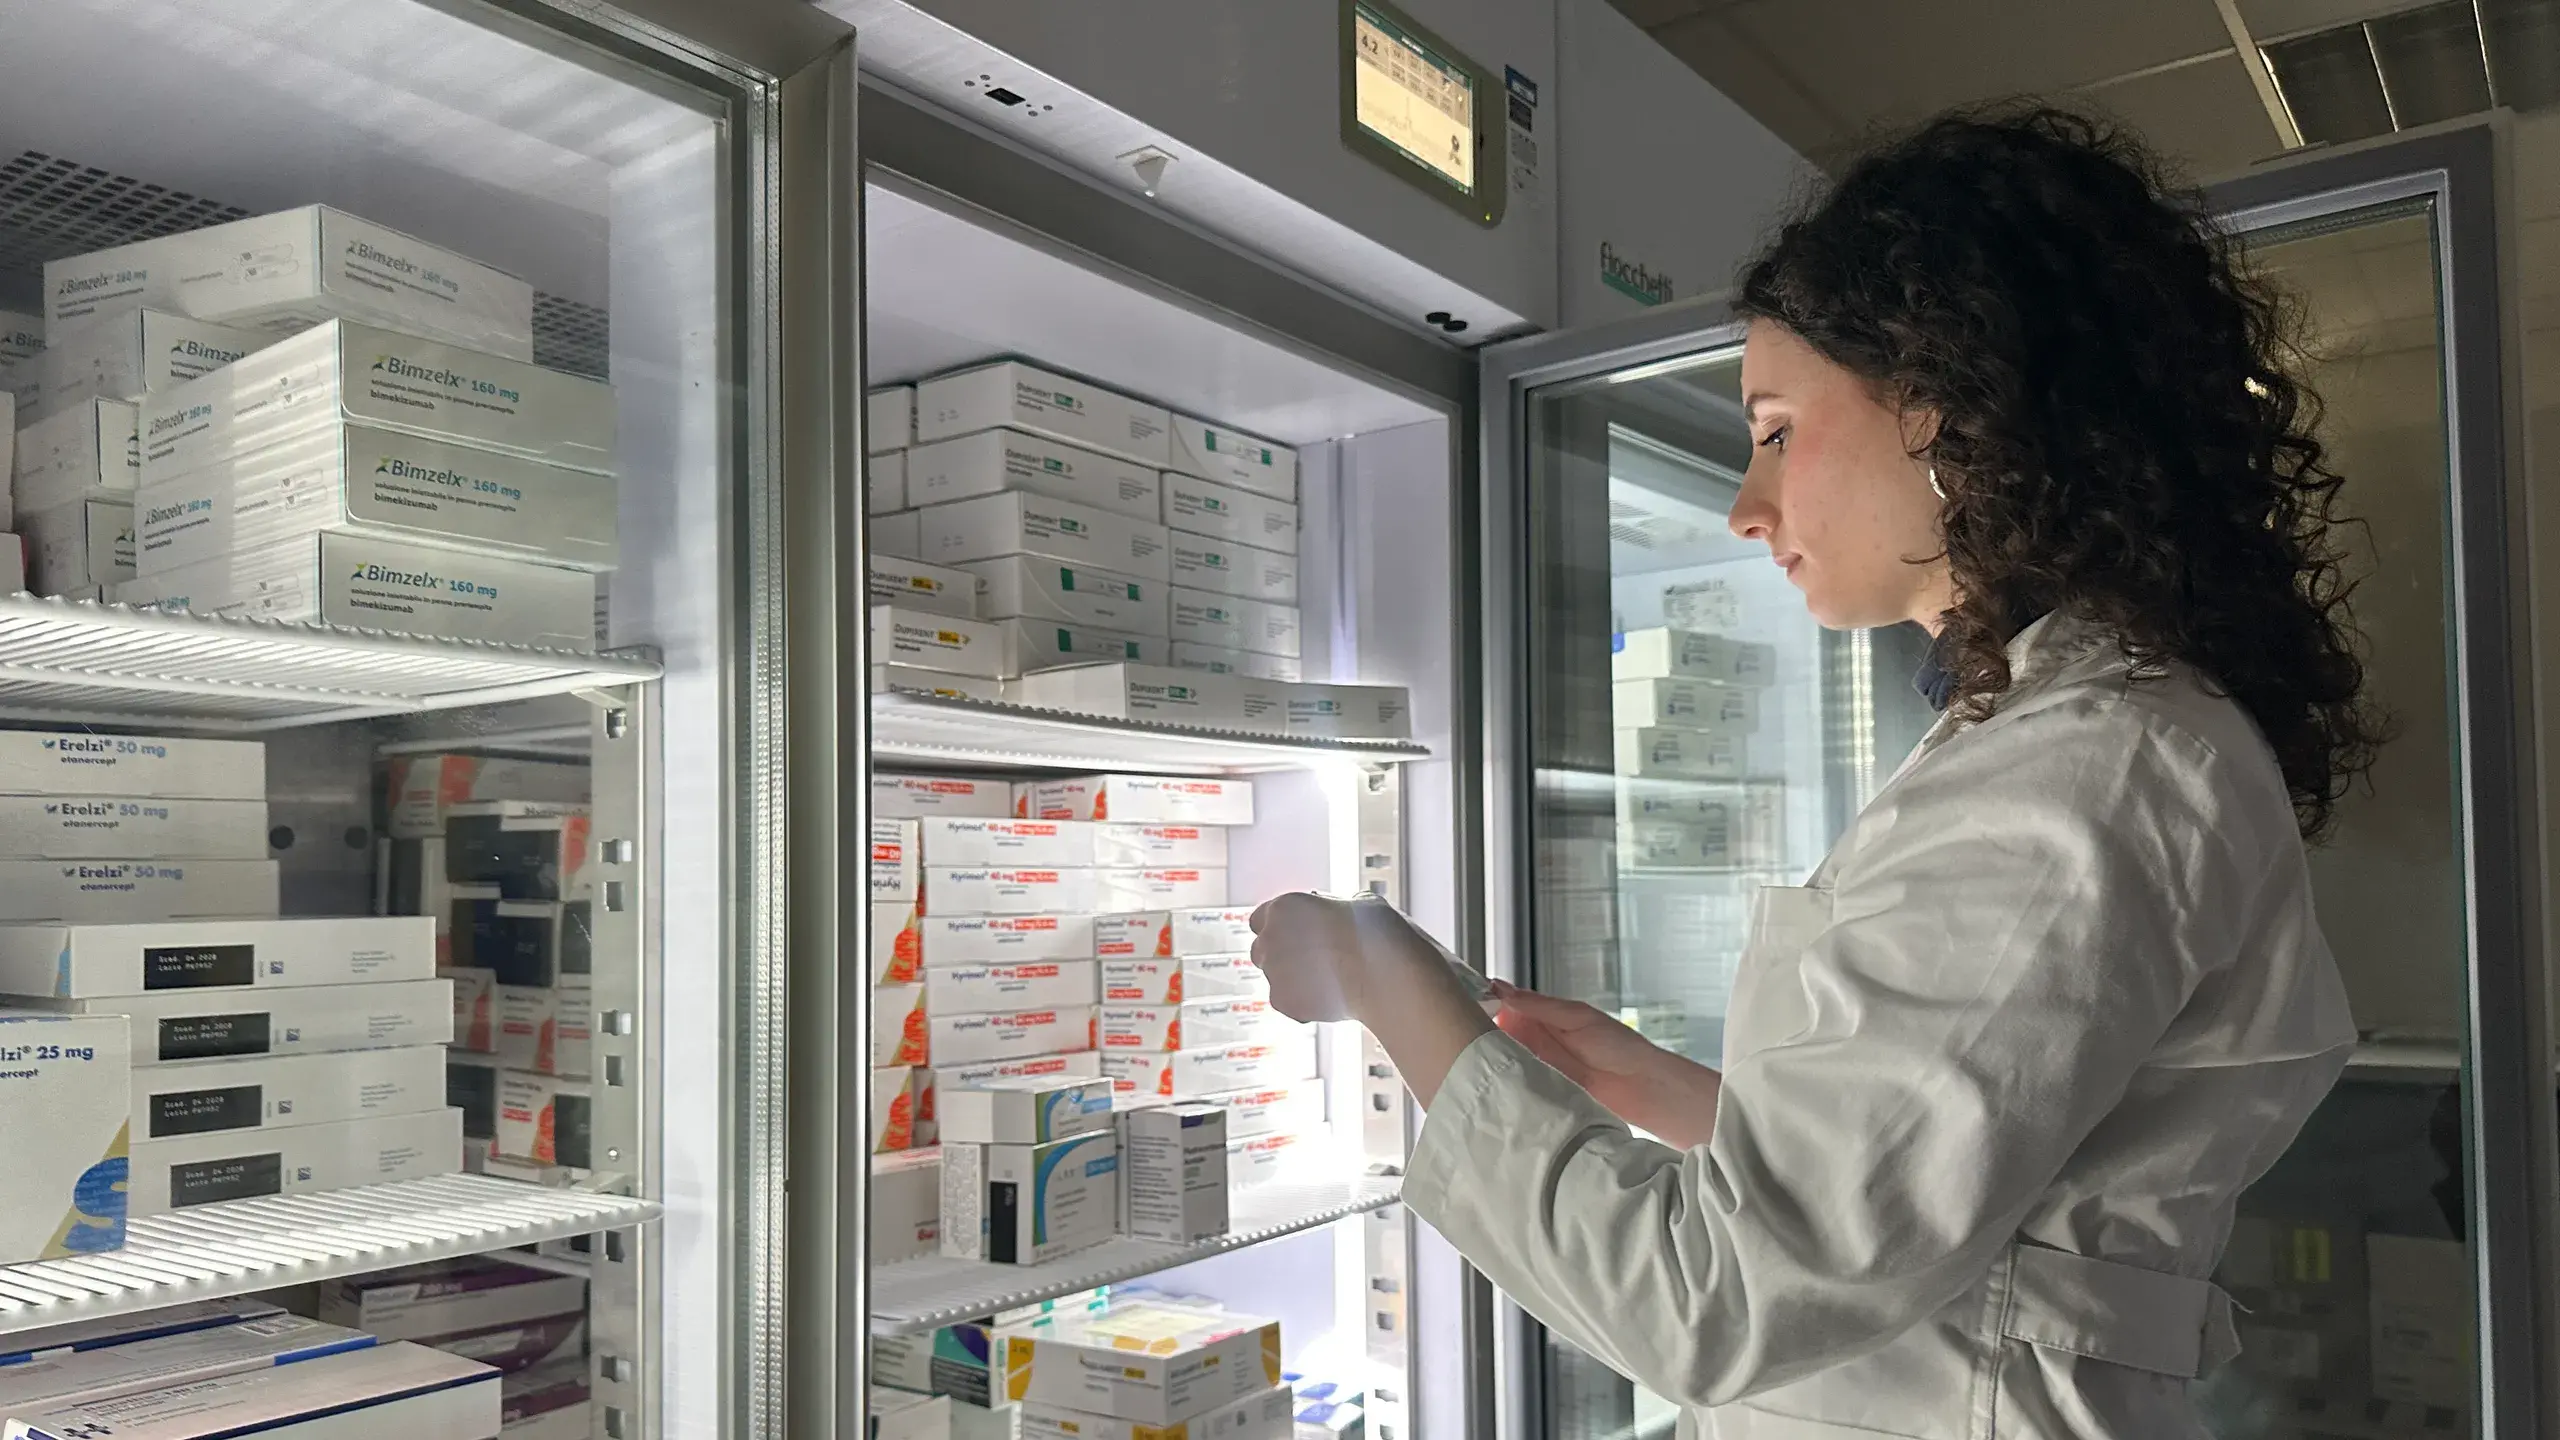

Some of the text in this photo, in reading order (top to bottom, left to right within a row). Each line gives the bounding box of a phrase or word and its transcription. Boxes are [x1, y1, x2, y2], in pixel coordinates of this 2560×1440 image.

[471, 379, 496, 395] 160
[500, 387, 520, 403] mg
[473, 479, 498, 494] 160
[500, 485, 521, 501] mg
[449, 580, 474, 594] 160
[477, 585, 498, 599] mg
[141, 745, 166, 758] mg
[143, 806, 168, 819] mg
[159, 868, 183, 880] mg
[37, 1046, 60, 1060] 25
[65, 1047, 94, 1061] mg
